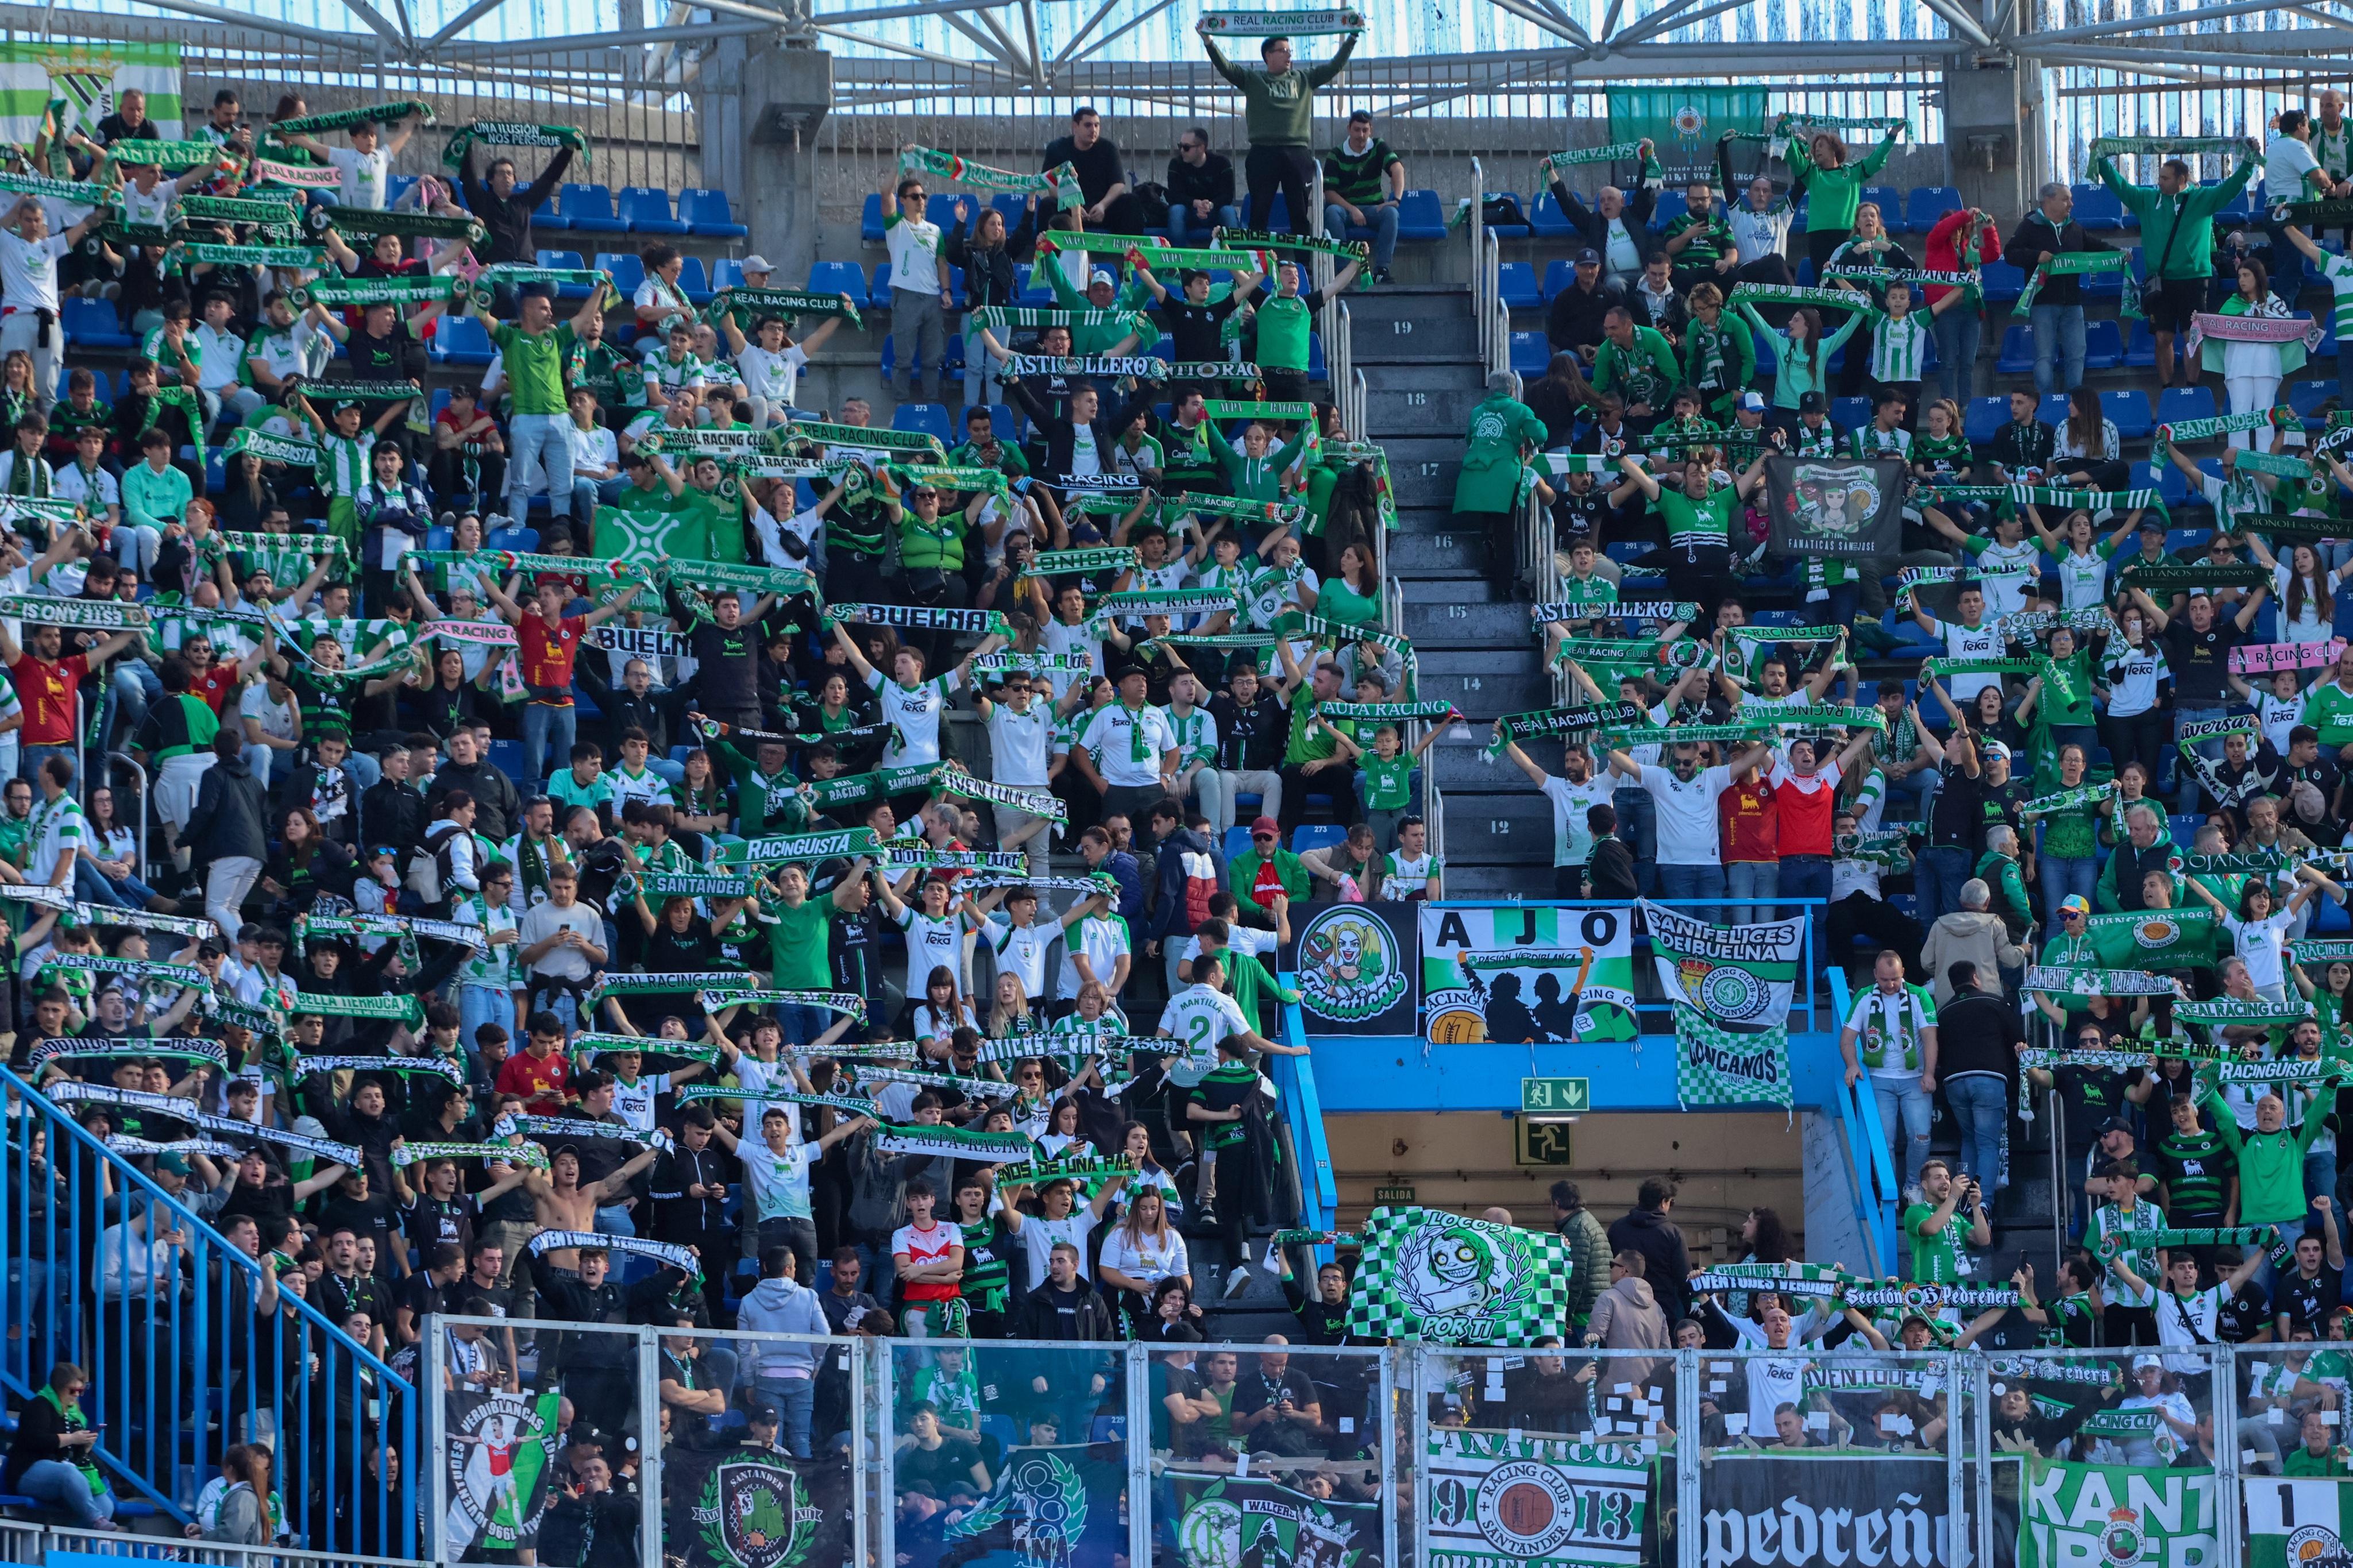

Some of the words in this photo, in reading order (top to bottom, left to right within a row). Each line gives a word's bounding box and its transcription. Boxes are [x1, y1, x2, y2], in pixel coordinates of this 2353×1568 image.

[1234, 15, 1260, 26] REAL
[1263, 15, 1304, 25] RACING
[1307, 13, 1334, 24] CLUB
[473, 122, 495, 134] UNA
[498, 123, 539, 136] ILUSIÓN
[488, 134, 513, 144] NOS
[515, 134, 561, 146] PERSIGUE
[184, 195, 217, 214] REAL
[220, 198, 262, 220] RACING
[1159, 252, 1183, 263] AUPA
[1209, 254, 1244, 265] RACING
[314, 288, 350, 301] CLUB
[353, 288, 400, 301] RACING
[402, 286, 445, 299] REAL
[735, 292, 762, 305] REAL
[764, 295, 805, 307] RACING
[810, 298, 838, 309] CLUB
[1394, 321, 1412, 335] 19
[2225, 319, 2269, 332] RACING
[2271, 322, 2301, 333] CLUB
[1407, 392, 1426, 405] 18
[1219, 401, 1243, 412] AUPA
[1270, 402, 1303, 414] RACING
[2175, 410, 2263, 435] SANTANDER
[805, 426, 836, 440] REAL
[839, 428, 892, 445] RACING
[896, 432, 926, 447] CLUB
[763, 457, 811, 468] RACING
[1421, 463, 1438, 476] 17
[1059, 474, 1139, 486] RACING
[259, 534, 309, 547] RACING
[1436, 535, 1452, 548] 16
[523, 554, 570, 570] RACING
[572, 557, 602, 570] CLUB
[1039, 549, 1133, 570] RACING
[672, 561, 707, 576] Real
[711, 565, 764, 586] Racing
[769, 570, 803, 587] Club
[1107, 595, 1150, 610] AUPA
[1166, 590, 1229, 608] RACING
[867, 604, 986, 632] BUELNA
[1449, 606, 1467, 618] 15
[1567, 646, 1588, 655] REAL
[1590, 647, 1623, 657] RACING
[1626, 649, 1649, 658] CLUB
[1939, 658, 1978, 669] REAL
[1981, 657, 2043, 666] RACING
[2044, 661, 2069, 694] CLUB
[1464, 678, 1481, 690] 14
[1324, 702, 1372, 716] AUPA
[1376, 701, 1445, 716] RACING
[1745, 706, 1781, 719] CLUB
[1786, 706, 1839, 717] RACING
[1844, 706, 1881, 723] REAL
[1512, 719, 1547, 732] REAL
[1549, 711, 1598, 729] RACING
[1602, 705, 1635, 721] CLUB
[1631, 728, 1671, 740] RACING
[1676, 726, 1743, 739] SANTANDER
[897, 767, 916, 777] CLUB
[832, 779, 854, 788] REAL
[828, 784, 866, 801] RACING
[1491, 821, 1509, 834] 12
[657, 876, 745, 895] SANTANDER
[1436, 912, 1472, 948] A
[1515, 910, 1537, 945] J
[1580, 912, 1618, 947] O
[2298, 941, 2344, 957] RACING
[1478, 951, 1508, 965] PASIÓN
[1515, 952, 1577, 965] VERDIBLANCA
[608, 975, 645, 988] REAL
[646, 975, 703, 988] RACING
[706, 973, 744, 986] CLUB
[1704, 968, 1736, 989] RACING
[1738, 970, 1756, 995] CLUB
[297, 993, 338, 1007] BELLA
[342, 995, 399, 1010] TIERRUCA
[1180, 997, 1222, 1014] MANTILLA
[1704, 998, 1756, 1017] SANTANDER
[2182, 1003, 2217, 1015] REAL
[2219, 1003, 2270, 1015] RACING
[2272, 1003, 2306, 1014] CLUB
[1189, 1016, 1210, 1055] 2
[1685, 1030, 1777, 1084] CONCANOS
[1266, 1111, 1274, 1120] MF
[1378, 1188, 1413, 1200] SALIDA
[1427, 1211, 1505, 1233] LOCOS
[2269, 1243, 2288, 1260] RRC
[1843, 1286, 1903, 1307] Sección
[1942, 1283, 2019, 1306] Pedreñera
[1419, 1316, 1468, 1339] POR
[1470, 1318, 1496, 1339] TI
[1995, 1332, 2006, 1346] 6
[461, 1399, 546, 1432] VERDIBLANCAS
[452, 1440, 488, 1529] JUVENTUDES
[730, 1470, 784, 1492] SANTANDER
[1483, 1465, 1537, 1497] RACING
[1540, 1470, 1571, 1504] CLUB
[2278, 1484, 2295, 1527] 1
[1583, 1490, 1634, 1540] 13
[488, 1521, 517, 1540] 1996
[2109, 1521, 2136, 1534] RACING
[1482, 1519, 1569, 1554] SANTANDER
[2103, 1552, 2140, 1567] SANTANDER
